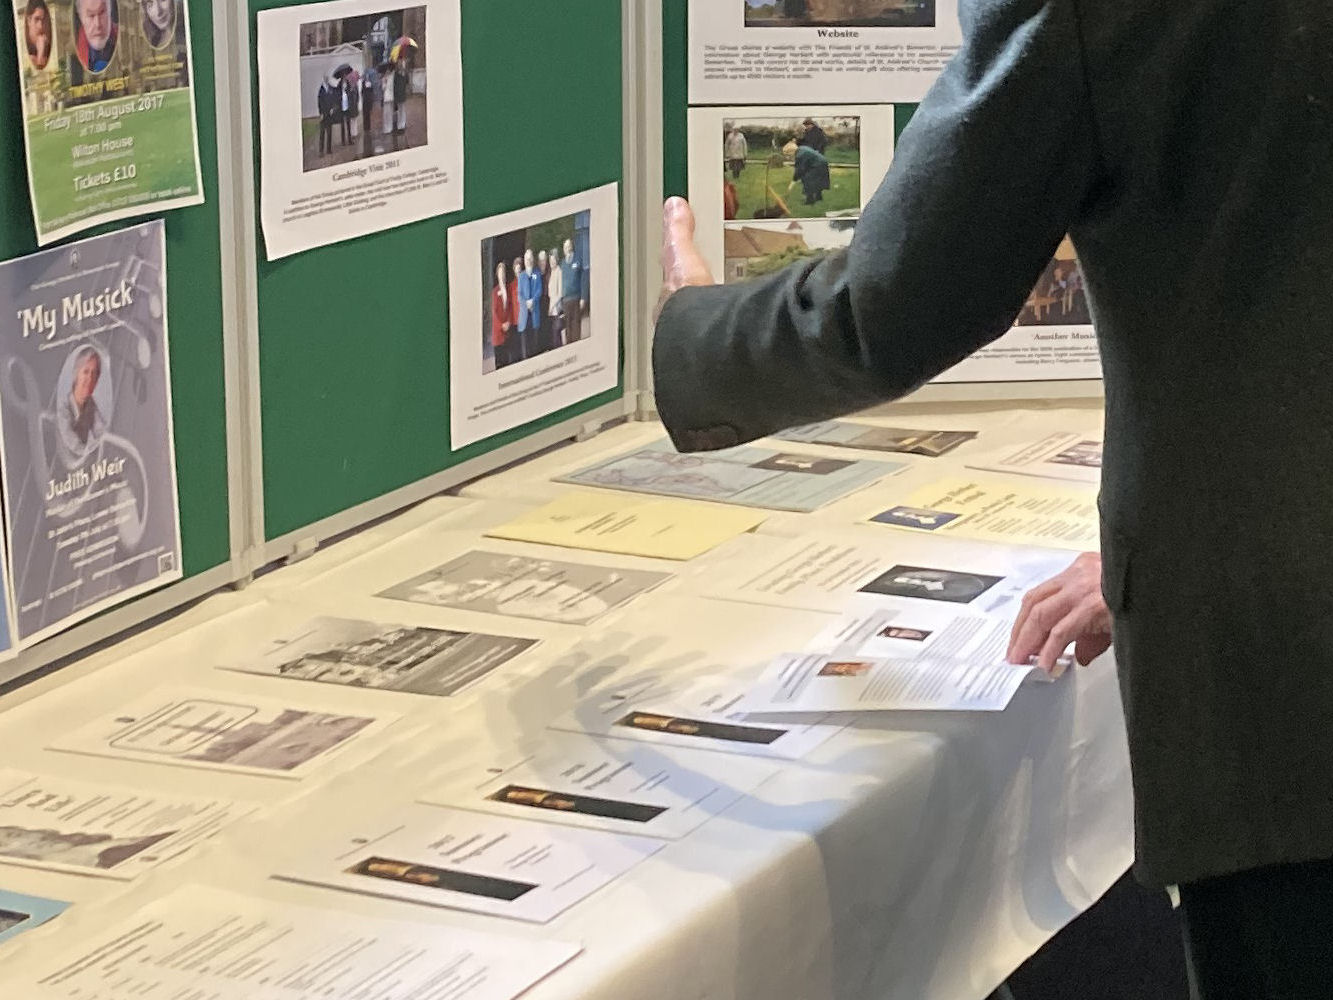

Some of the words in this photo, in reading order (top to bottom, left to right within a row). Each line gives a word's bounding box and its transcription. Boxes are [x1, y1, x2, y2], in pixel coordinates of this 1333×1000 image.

[816, 29, 859, 38] Website
[68, 82, 104, 99] TIMOTHY
[106, 76, 130, 91] WEST
[44, 116, 71, 131] Friday
[75, 110, 95, 124] 18th
[97, 102, 136, 120] August
[138, 94, 165, 112] 2017
[71, 143, 101, 158] Wilton
[101, 135, 134, 151] House
[73, 171, 111, 191] Tickets
[113, 163, 136, 181] £10
[17, 304, 56, 340] 'My
[61, 277, 136, 326] Musick'
[45, 469, 90, 501] Judith
[91, 457, 126, 482] Weir
